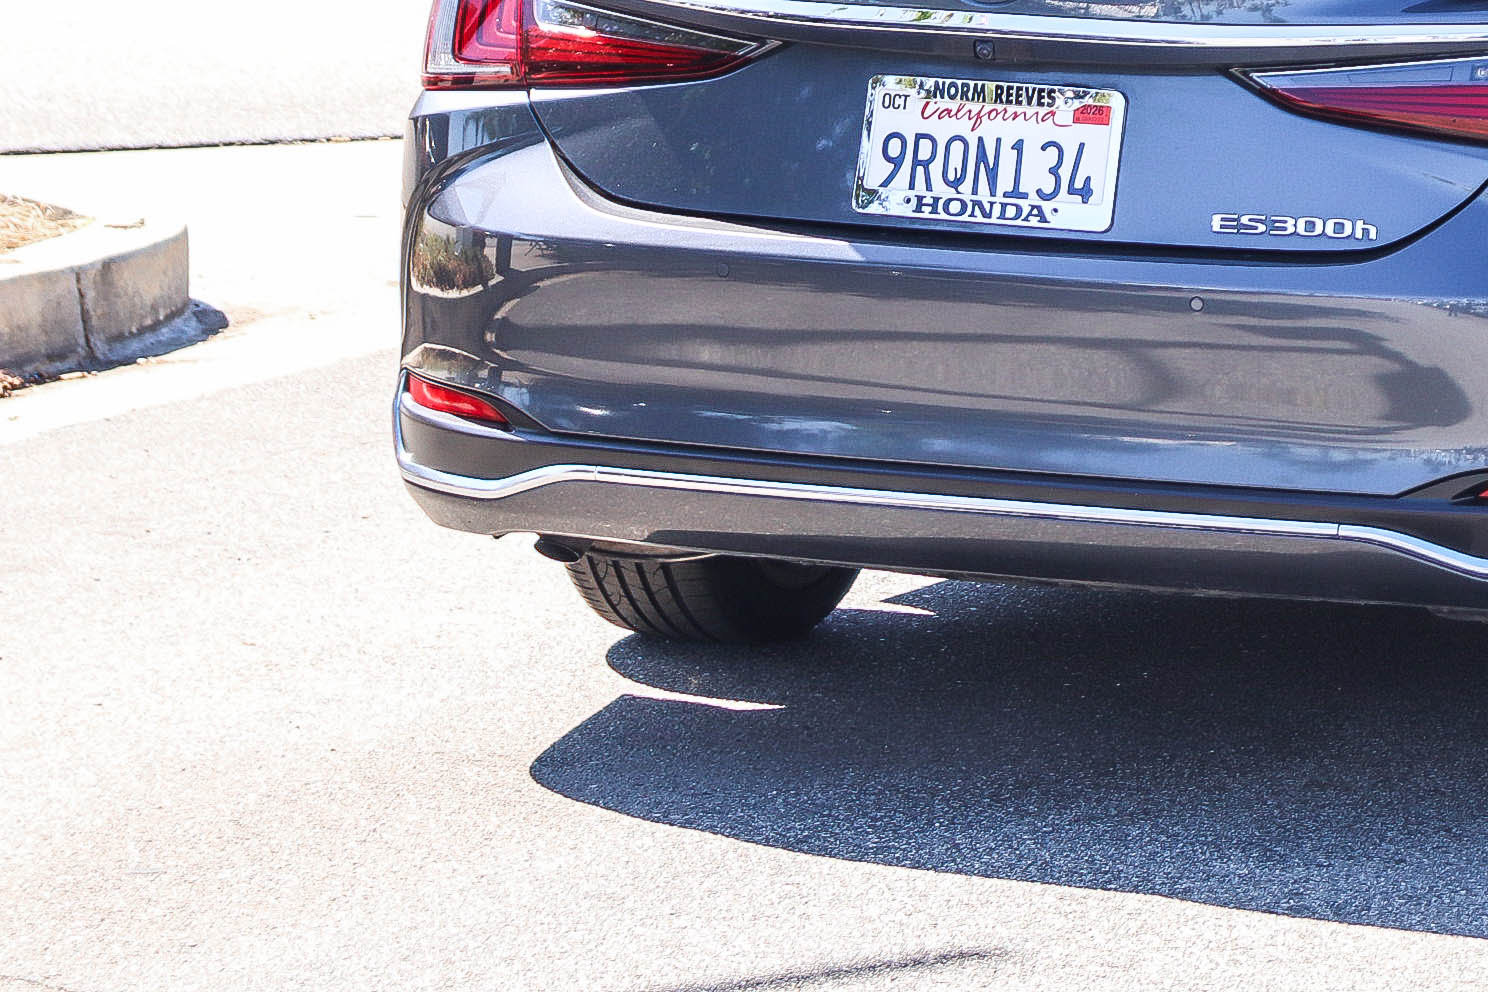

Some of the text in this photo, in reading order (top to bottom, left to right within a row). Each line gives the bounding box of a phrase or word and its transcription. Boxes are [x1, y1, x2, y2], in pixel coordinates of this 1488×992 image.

[881, 92, 911, 111] OCT
[932, 80, 1057, 108] NORM REEVES
[920, 100, 1073, 133] California
[878, 131, 1094, 204] 9RQN134
[912, 194, 1051, 224] HONDA
[1210, 212, 1379, 242] ES300h
